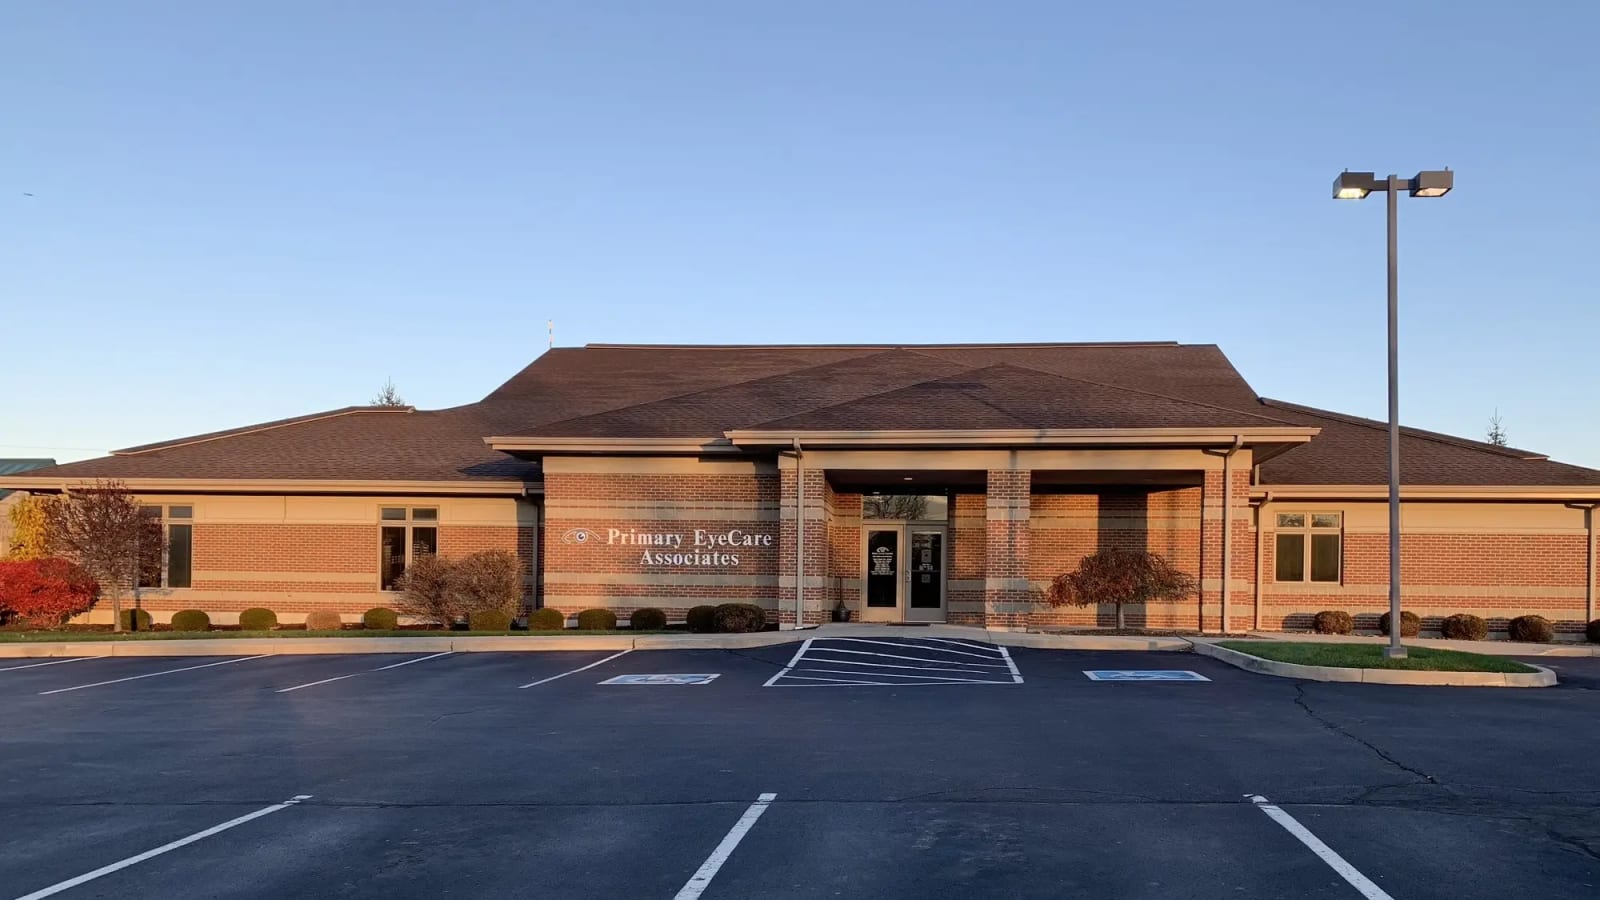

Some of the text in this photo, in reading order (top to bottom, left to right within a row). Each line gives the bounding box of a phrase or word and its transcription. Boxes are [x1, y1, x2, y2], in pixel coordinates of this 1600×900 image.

[607, 528, 773, 549] Primary EyeCare
[640, 549, 740, 566] Associates
